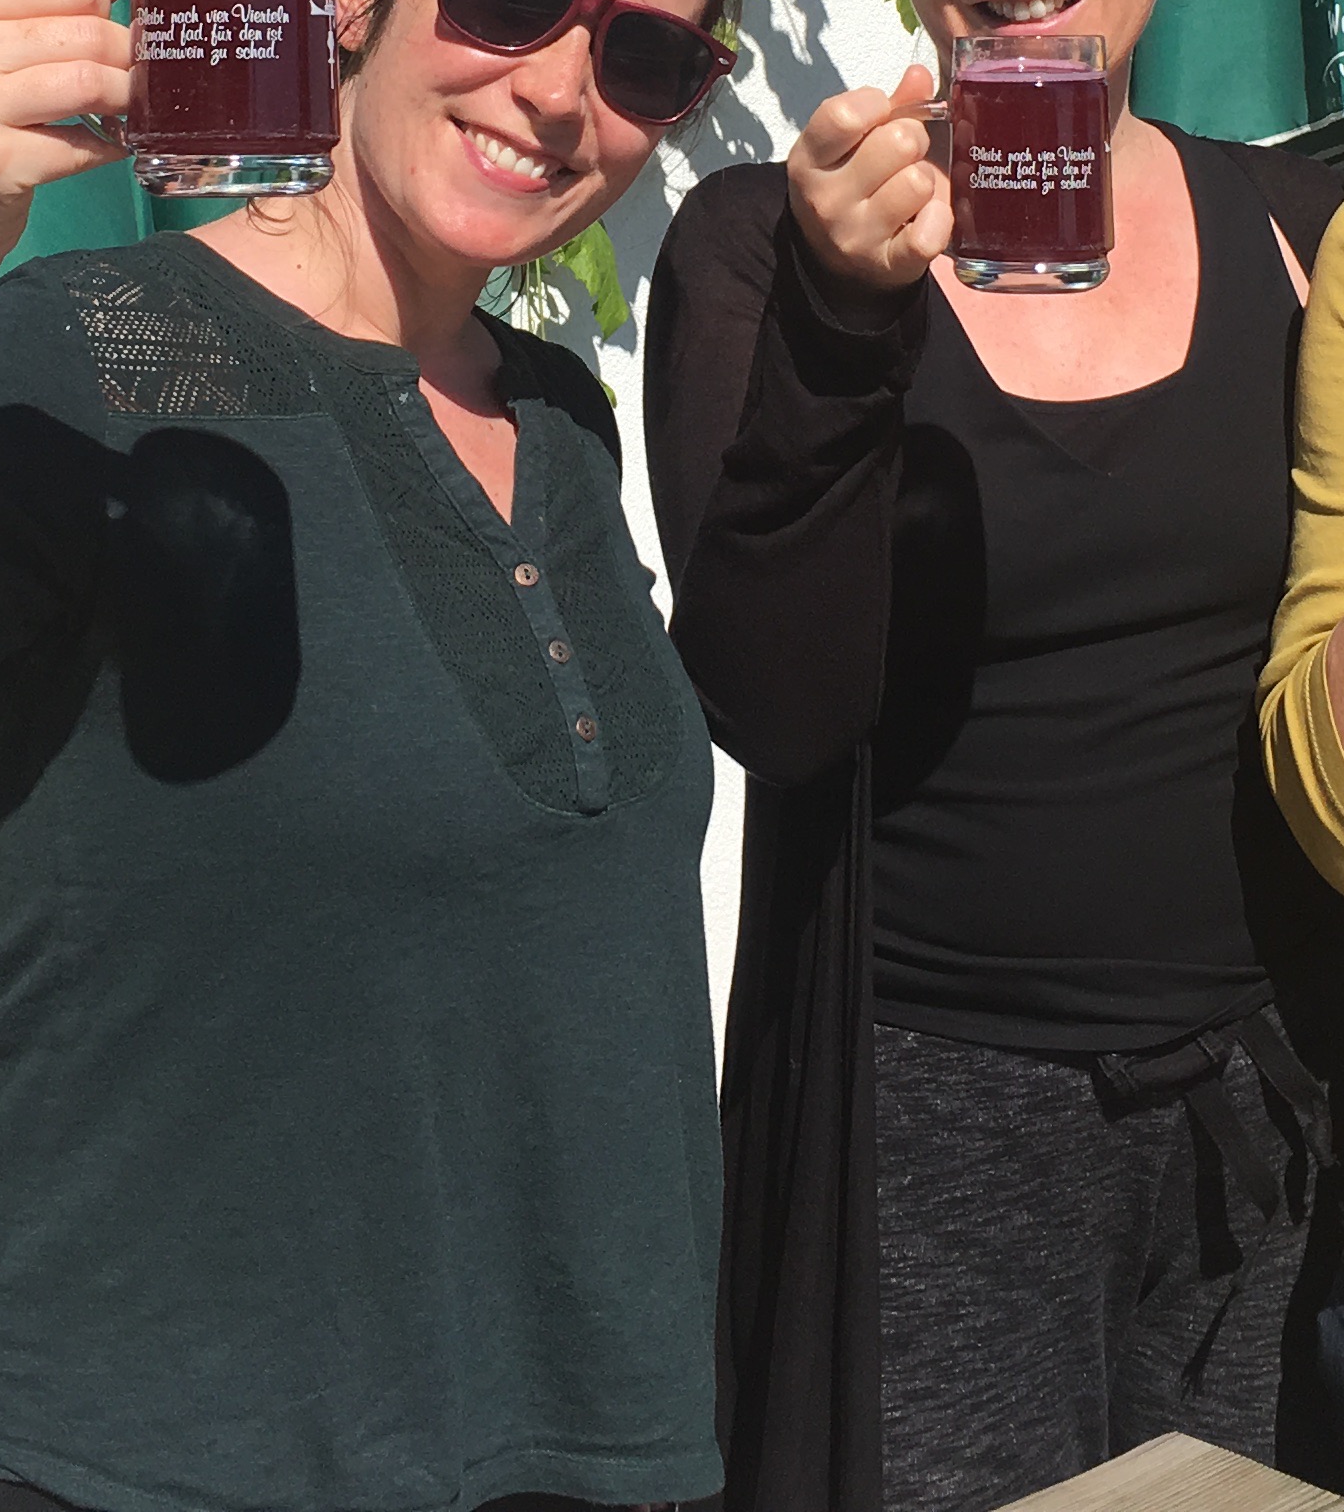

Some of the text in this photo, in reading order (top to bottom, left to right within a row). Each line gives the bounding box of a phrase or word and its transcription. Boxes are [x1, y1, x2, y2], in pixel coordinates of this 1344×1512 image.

[136, 3, 290, 26] Bleibt nach vier Vierteln
[239, 23, 263, 41] den
[267, 26, 284, 42] ist
[135, 41, 280, 66] Schilcherwein zu schad.
[969, 145, 1003, 162] Bleibt
[1008, 146, 1033, 162] nach
[1037, 150, 1056, 162] vier
[1062, 161, 1080, 176] den
[1081, 162, 1093, 176] ist
[969, 172, 1038, 190] Schilcherwein
[1041, 180, 1055, 196] zu
